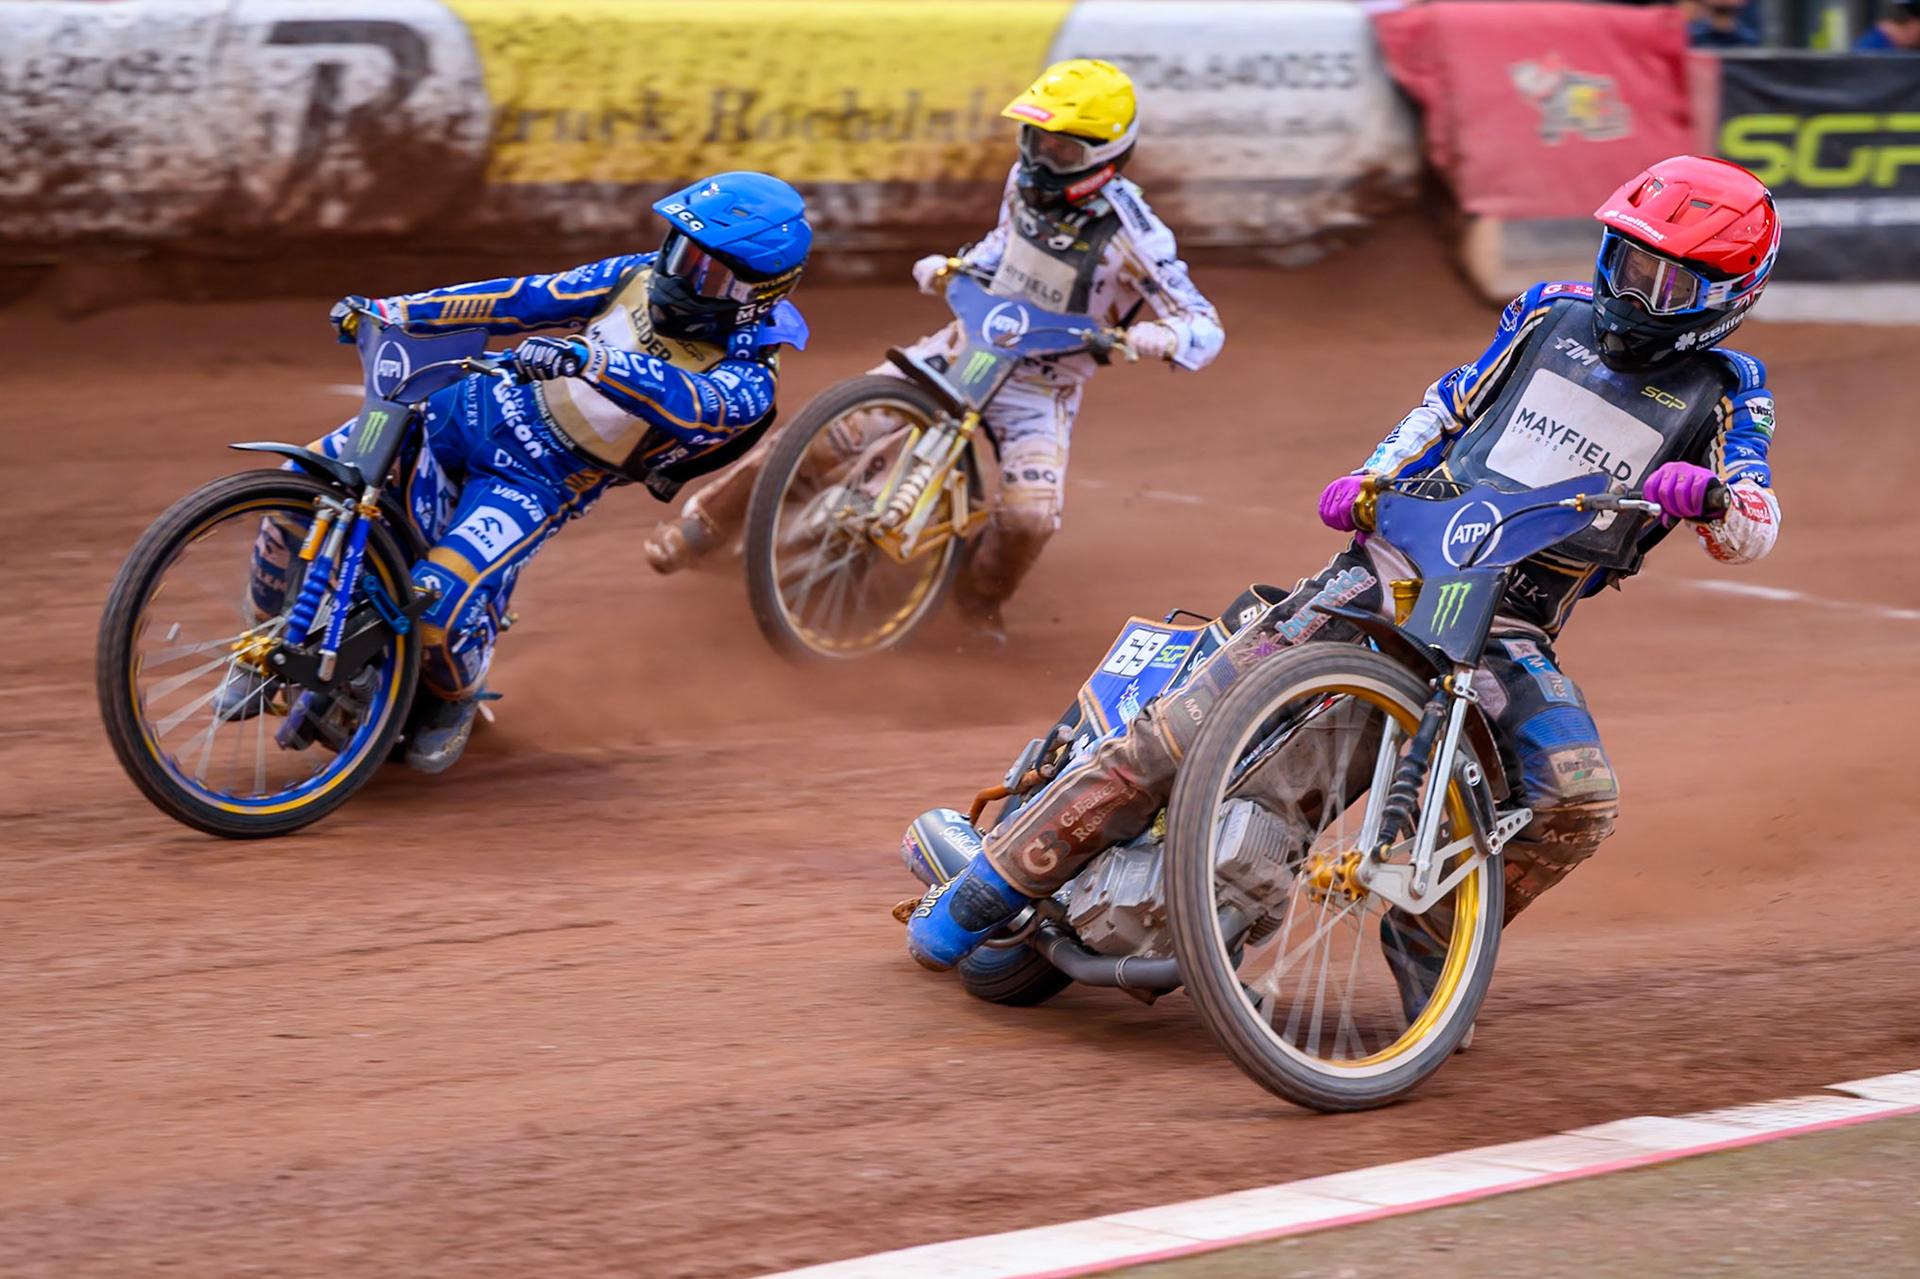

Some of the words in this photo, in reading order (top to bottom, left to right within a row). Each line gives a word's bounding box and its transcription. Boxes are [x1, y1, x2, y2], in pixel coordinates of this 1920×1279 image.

[1720, 113, 1920, 188] SGP
[631, 304, 672, 361] LEADER
[1555, 337, 1600, 366] FIM
[1641, 386, 1687, 411] SGP
[1515, 407, 1632, 482] MAYFIELD
[1102, 627, 1172, 678] 69
